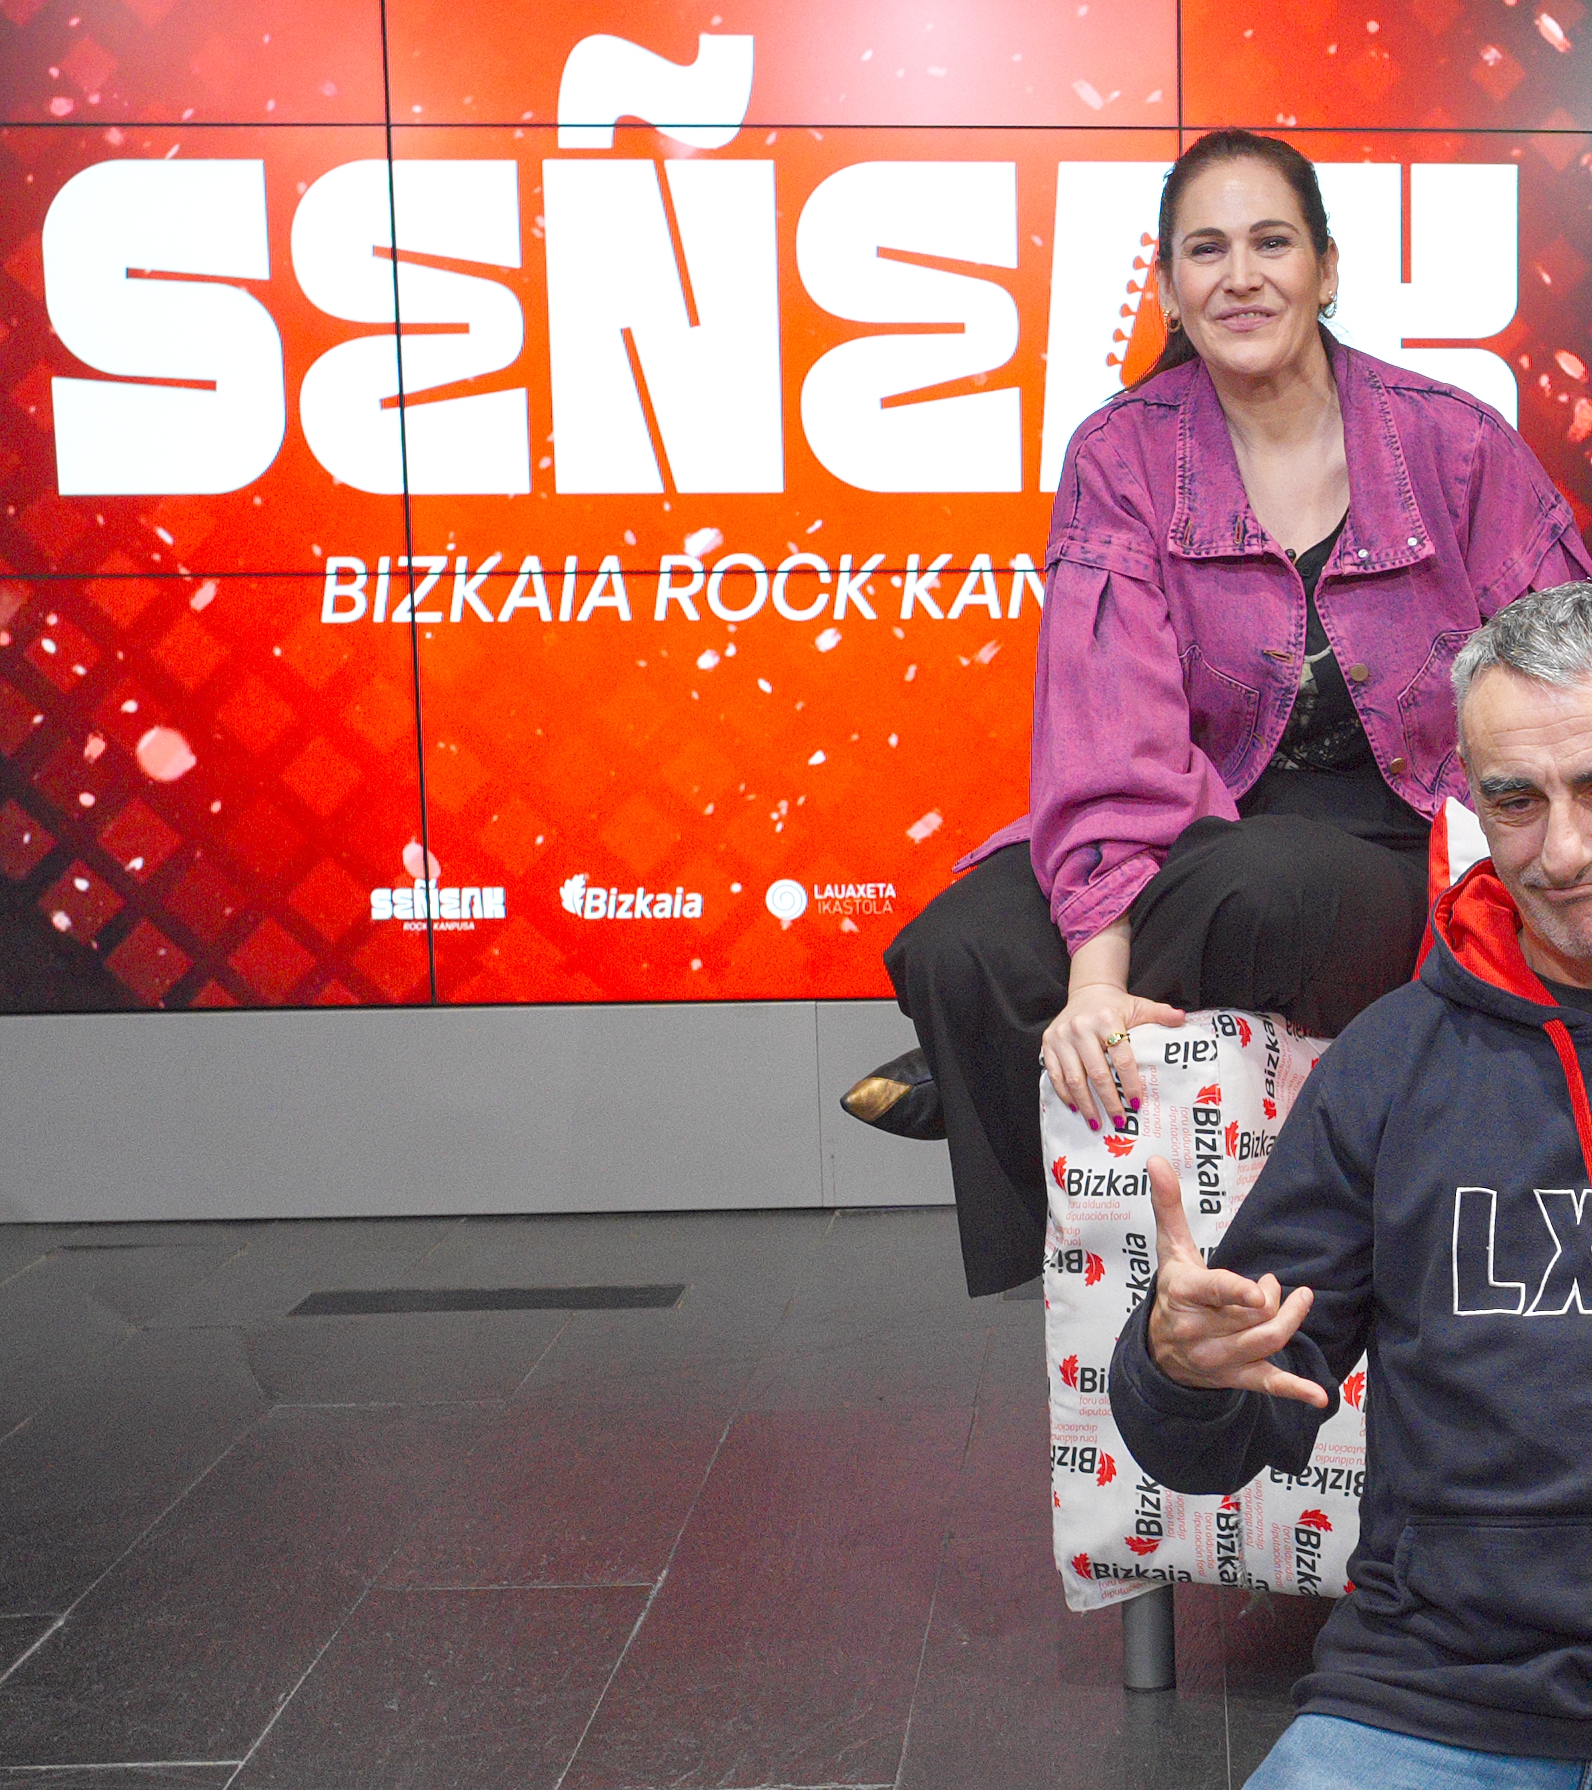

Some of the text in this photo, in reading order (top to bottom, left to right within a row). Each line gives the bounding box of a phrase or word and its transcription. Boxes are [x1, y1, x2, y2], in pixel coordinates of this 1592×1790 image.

[320, 555, 632, 625] BIZKAIA
[654, 552, 887, 623] ROCK
[583, 887, 703, 920] Bizkaia
[814, 883, 896, 899] LAUAXETA
[818, 899, 893, 915] IKASTOLA
[403, 921, 475, 931] ROCK KANPUSA
[1255, 1012, 1281, 1099] Bizkai
[1193, 1107, 1226, 1215] Bizkaia
[1067, 1168, 1151, 1197] Bizkai
[1082, 1200, 1120, 1210] aldundia
[1110, 1211, 1131, 1221] foral
[1135, 1476, 1163, 1536] Bizk
[1093, 1562, 1192, 1583] Bizkaia
